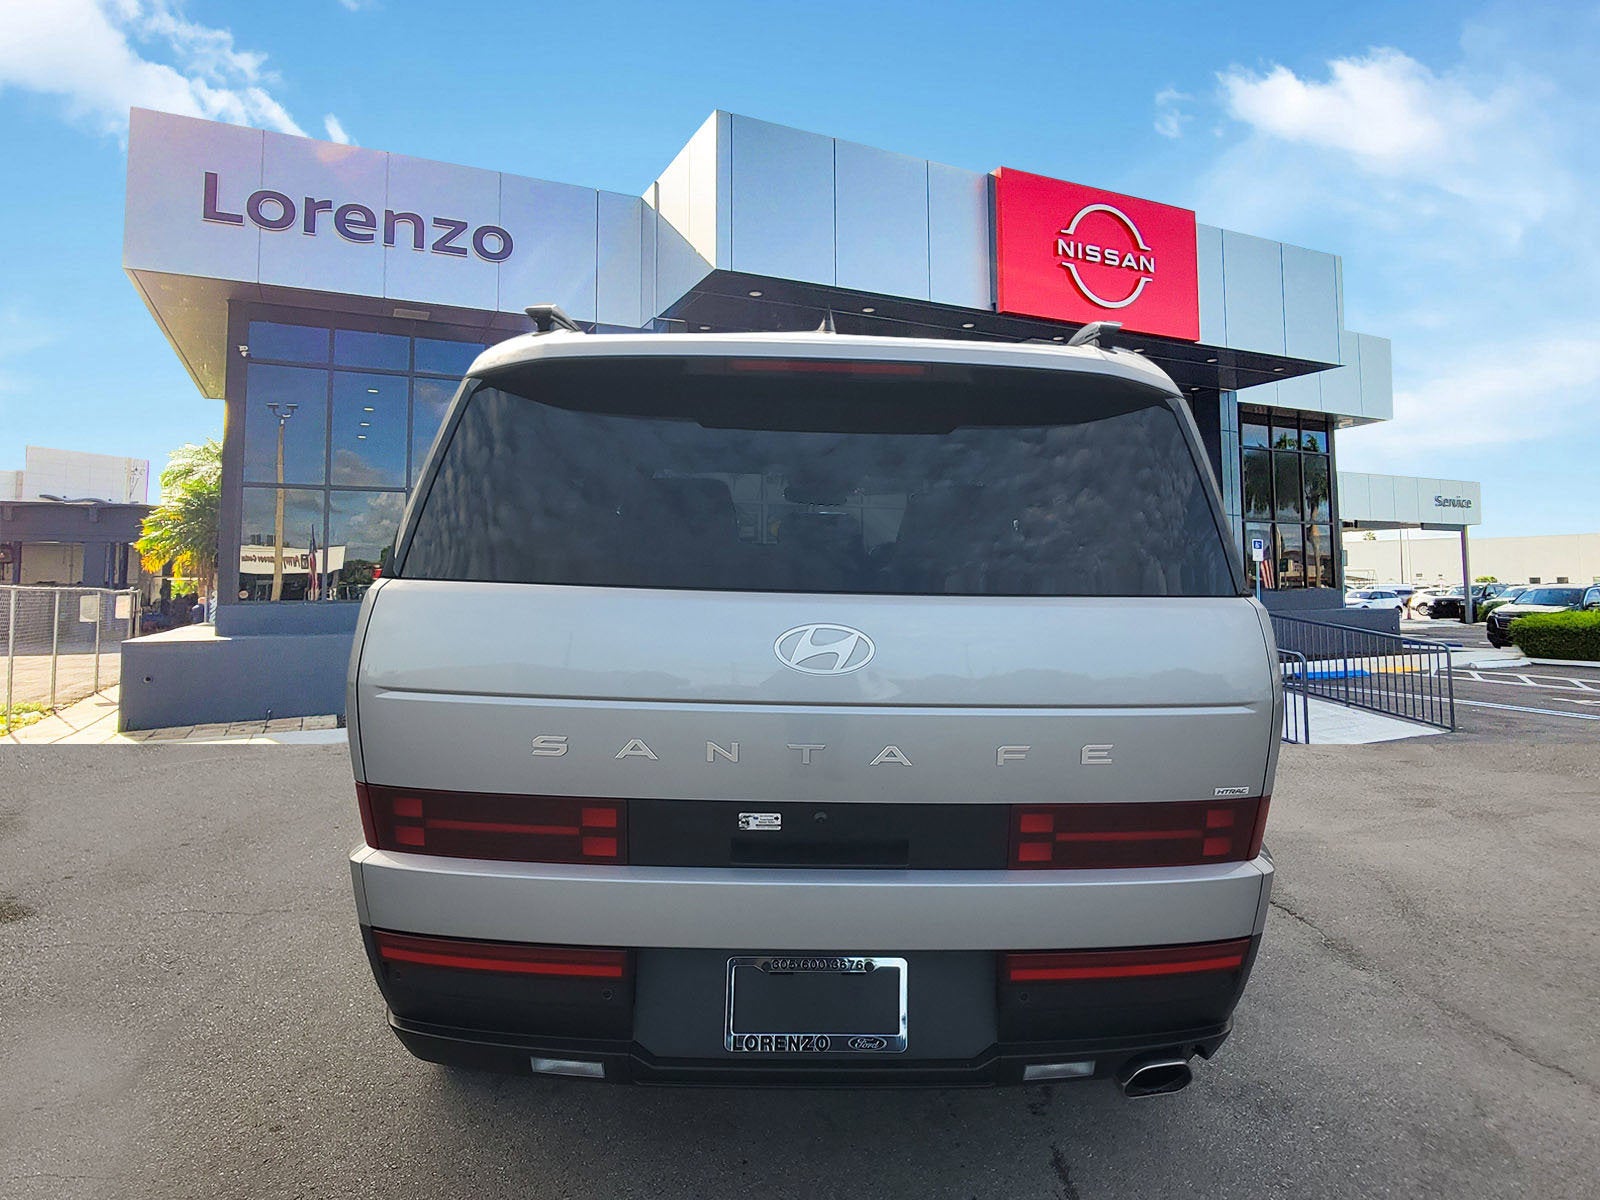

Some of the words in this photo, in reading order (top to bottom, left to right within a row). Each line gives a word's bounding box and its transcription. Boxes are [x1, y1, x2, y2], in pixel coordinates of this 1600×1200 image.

[203, 171, 514, 262] Lorenzo
[1057, 238, 1155, 273] NISSAN
[1435, 495, 1471, 508] Service
[531, 735, 912, 766] SANTA
[996, 744, 1115, 766] FE
[1216, 787, 1248, 795] HTRAC
[732, 1034, 831, 1052] LORENZO
[853, 1037, 881, 1049] Ford
